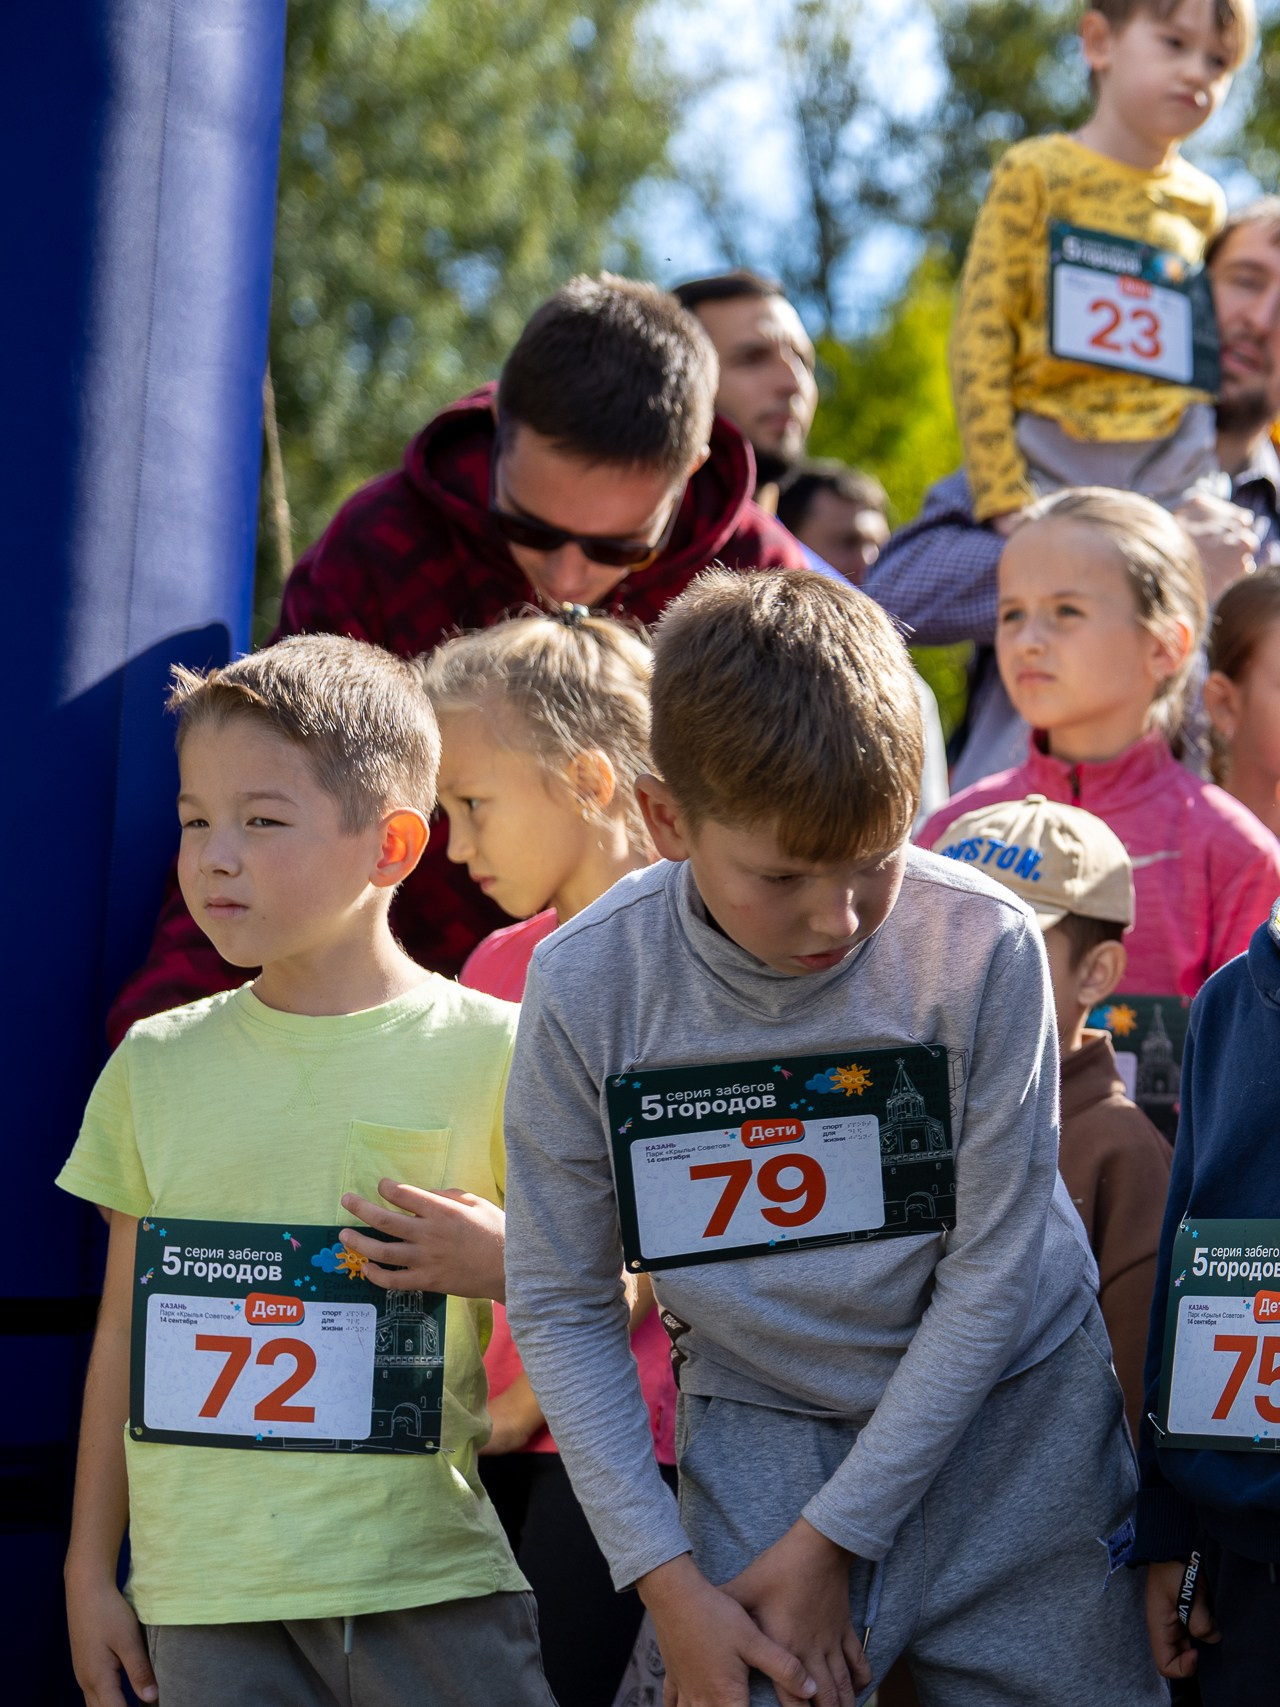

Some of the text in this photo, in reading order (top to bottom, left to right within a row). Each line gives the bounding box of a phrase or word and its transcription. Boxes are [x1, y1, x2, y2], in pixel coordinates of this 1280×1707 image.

[1089, 298, 1164, 360] 23
[666, 1081, 775, 1102] серия забегов
[641, 1094, 777, 1121] 5 городов
[749, 1124, 797, 1142] Дети
[822, 1123, 843, 1131] спорт
[645, 1142, 677, 1151] КАЗАНЬ
[823, 1136, 846, 1144] жизни
[645, 1142, 731, 1158] Парк «Крылья Советов»
[656, 1153, 691, 1162] сентября
[689, 1153, 827, 1238] 79
[185, 1246, 282, 1262] серия забегов
[1192, 1247, 1209, 1277] 5
[1211, 1246, 1242, 1261] серия
[162, 1246, 282, 1283] 5 городов
[176, 1311, 205, 1319] «Крылья
[205, 1312, 234, 1320] Советов»
[252, 1301, 298, 1318] Дети
[195, 1333, 317, 1423] 72
[1180, 1551, 1201, 1601] URBAN
